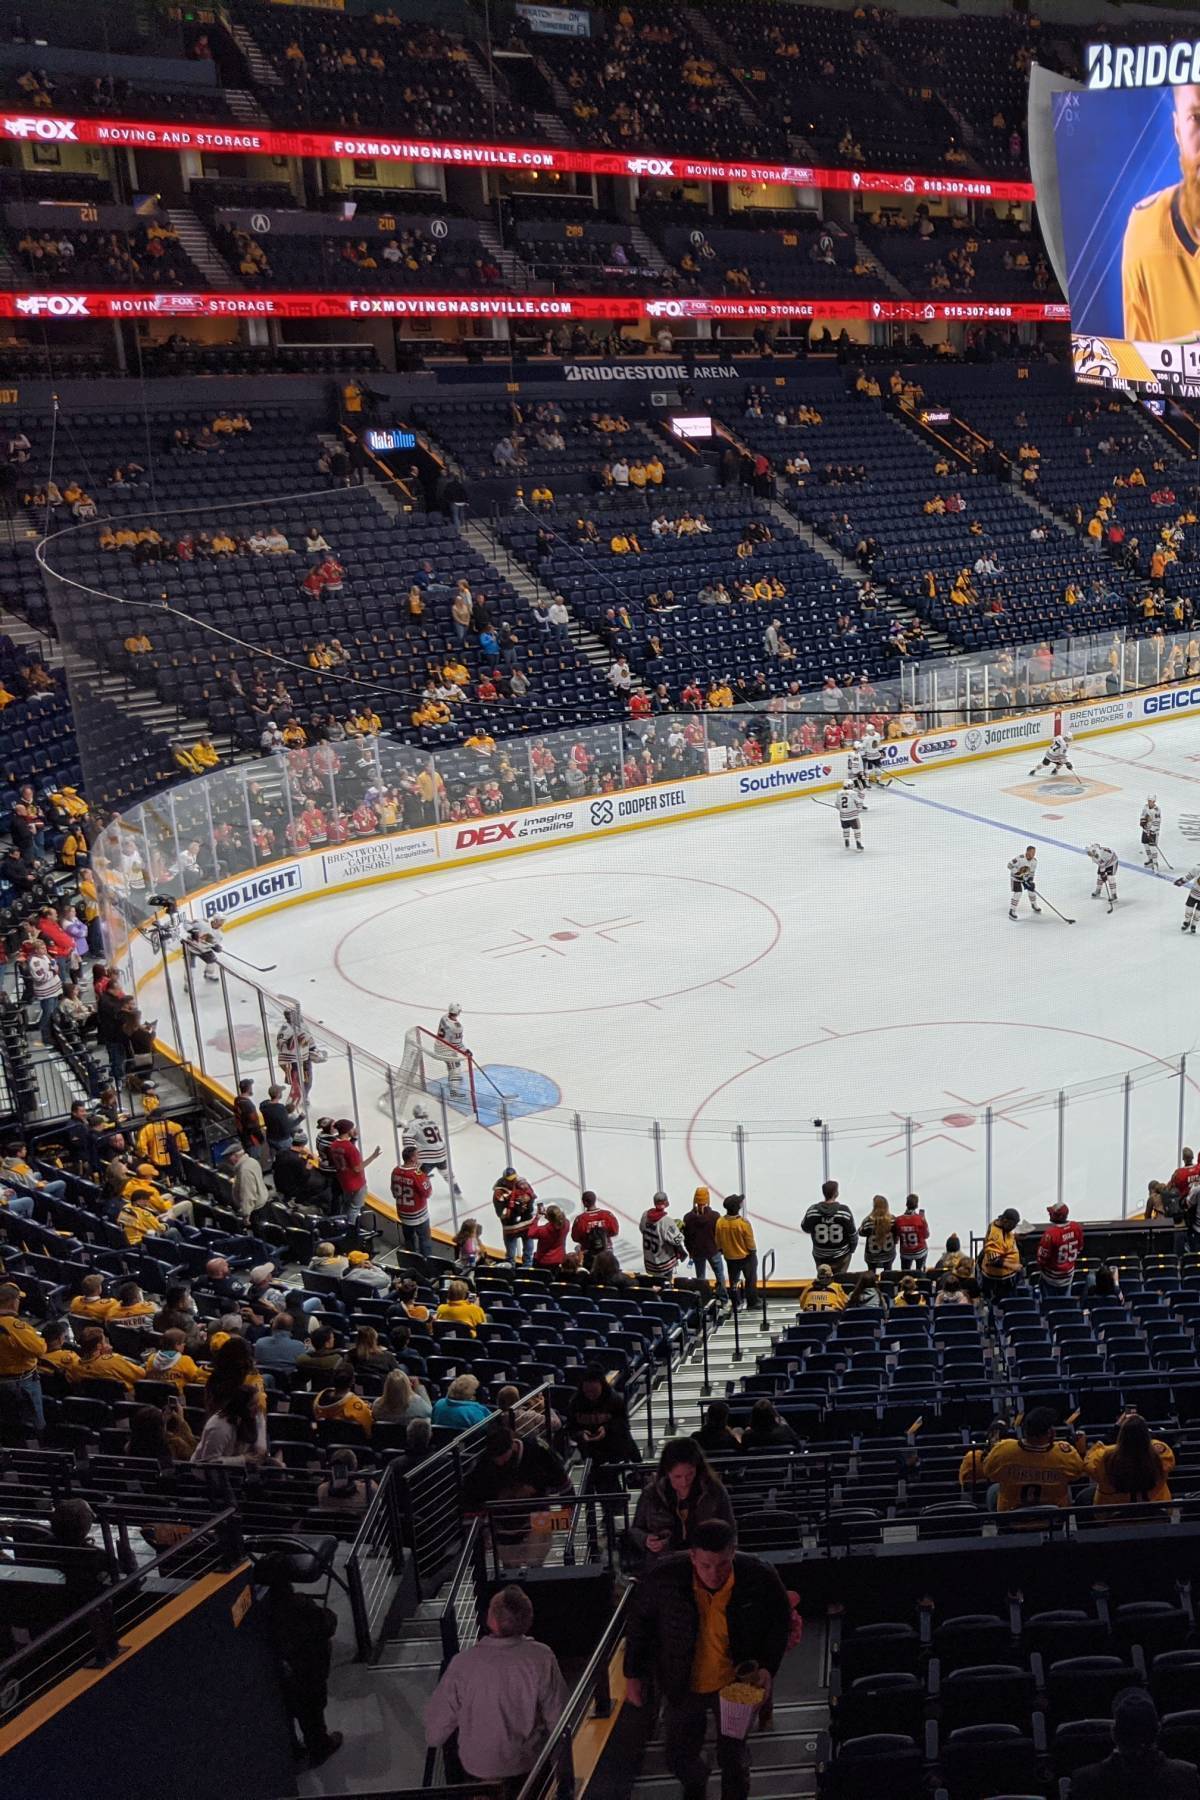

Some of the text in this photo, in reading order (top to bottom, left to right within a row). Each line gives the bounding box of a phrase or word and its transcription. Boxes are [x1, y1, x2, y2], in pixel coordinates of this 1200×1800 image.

[20, 118, 260, 148] FOX MOVING AND STORAGE
[334, 140, 554, 166] FOXMOVINGNASHVILLE.COM
[636, 158, 787, 180] FOX MOVING AND STORAG
[31, 296, 157, 315] FOX MOVIN
[209, 301, 275, 312] STORAGE
[350, 300, 572, 313] FOXMOVINGNASHVILLE.COM
[714, 305, 813, 315] OVING AND STORAGE
[943, 306, 1012, 317] 615-307-6408
[1160, 349, 1173, 368] 0
[563, 365, 740, 381] BRIDGESTONE ARENA
[1172, 373, 1180, 384] 0
[1112, 377, 1131, 391] NHL
[1145, 382, 1165, 395] COL
[370, 430, 417, 450] datablue
[1069, 703, 1124, 721] BRENTWOOD
[1069, 712, 1124, 730] AUTO BROKERS
[739, 764, 822, 794] Southwest
[618, 789, 687, 817] COOPER STEEL
[840, 796, 849, 809] 2
[455, 811, 573, 850] DEX imaging
[518, 819, 574, 837] & mailing
[327, 843, 390, 865] BRENTWOOD
[394, 841, 420, 854] Mergers
[347, 847, 435, 868] CAPITAL Acquisitions
[341, 860, 392, 878] ADVISORS
[204, 869, 298, 919] BUD LIGHT
[813, 1223, 844, 1244] 88
[1057, 1240, 1079, 1264] 65
